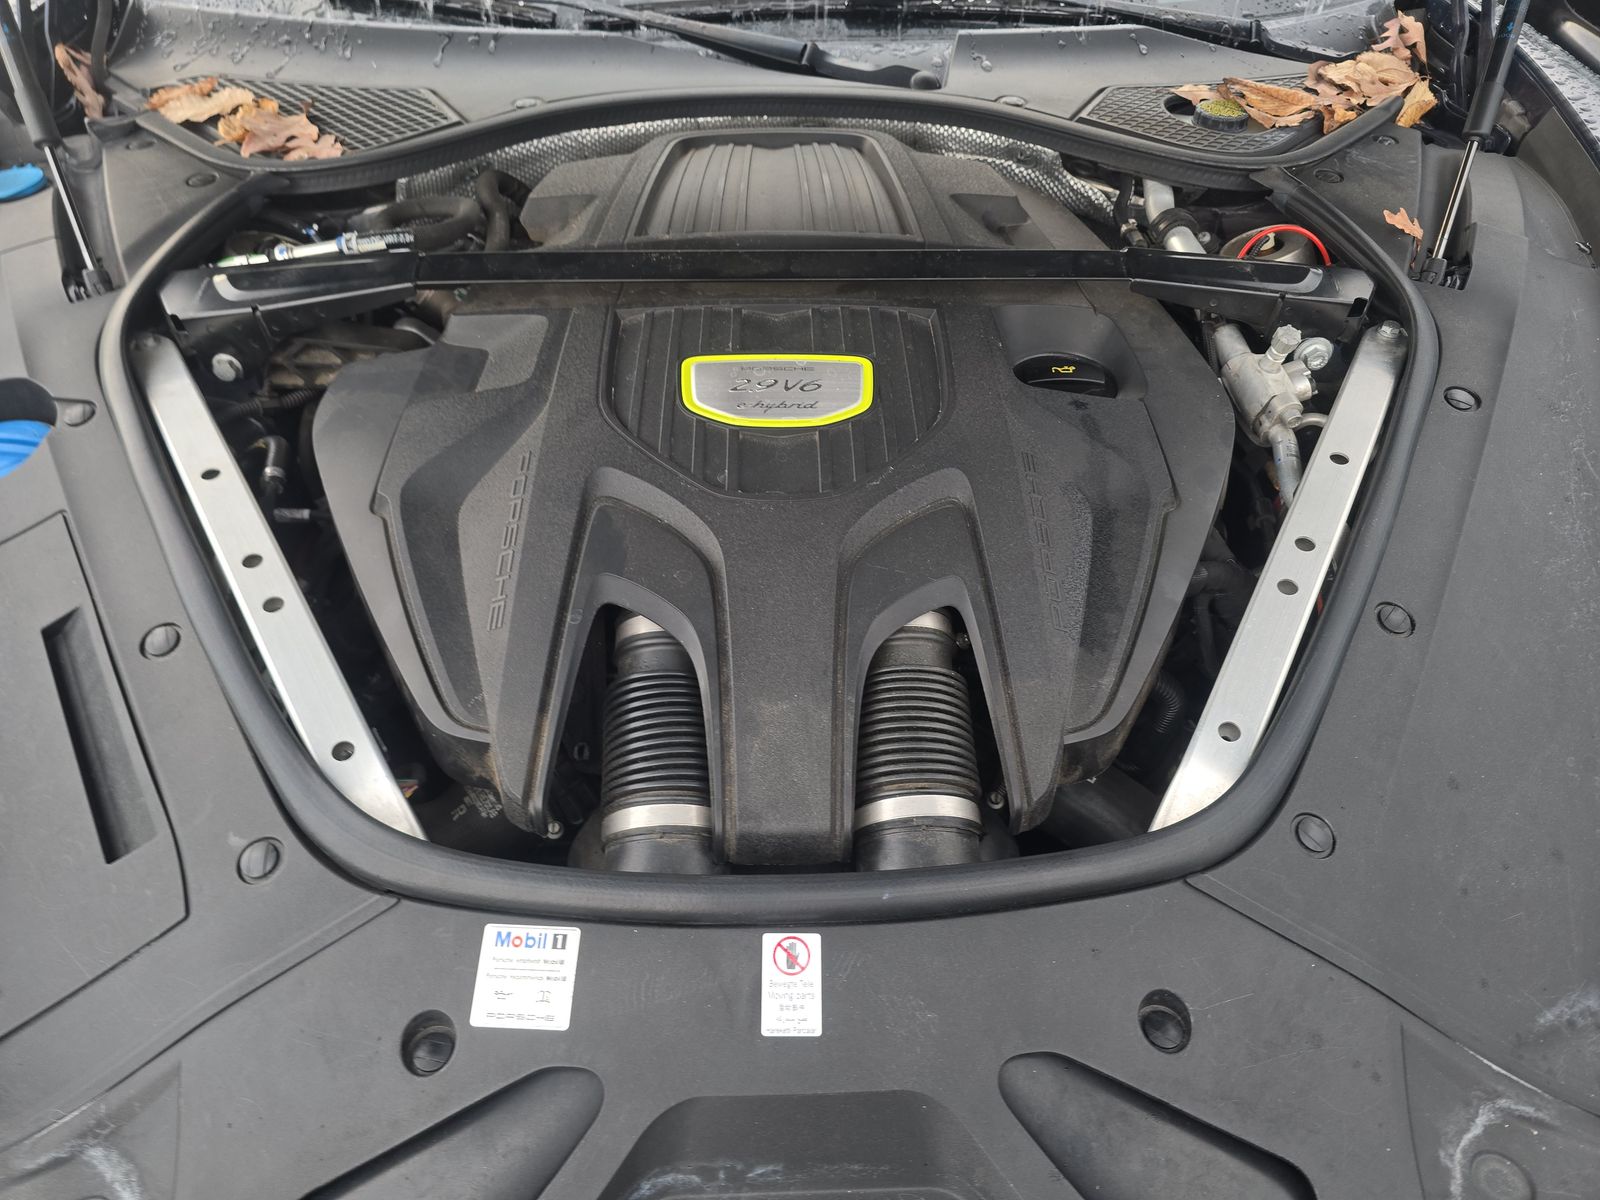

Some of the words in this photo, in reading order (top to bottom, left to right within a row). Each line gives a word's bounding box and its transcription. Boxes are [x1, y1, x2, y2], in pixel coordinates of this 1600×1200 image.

[729, 378, 779, 393] 2.9
[784, 378, 823, 392] V6
[486, 450, 533, 632] PORSCHE
[1020, 450, 1072, 635] PORSCHE
[494, 931, 548, 949] Mobil
